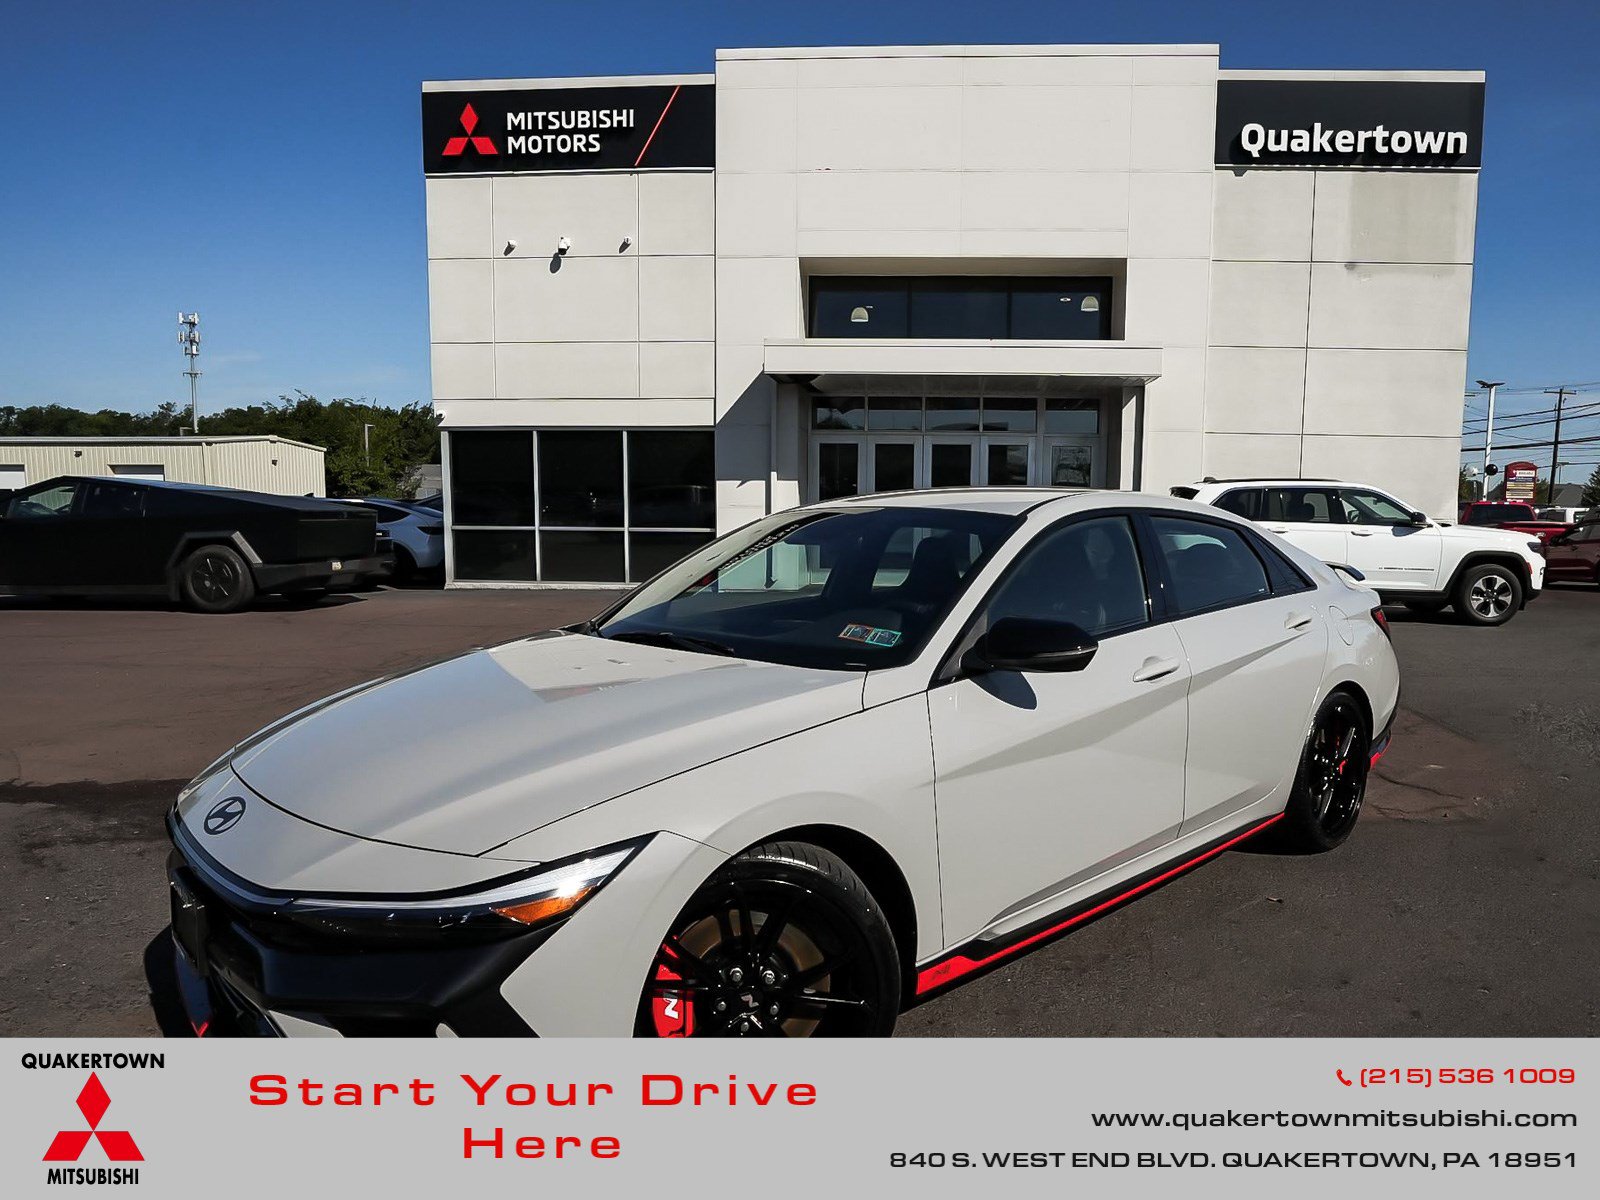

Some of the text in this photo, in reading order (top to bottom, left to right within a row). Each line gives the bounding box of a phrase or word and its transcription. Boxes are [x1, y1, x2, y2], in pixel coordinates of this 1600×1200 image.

[506, 109, 635, 131] MITSUBISHI
[507, 133, 601, 155] MOTORS
[1240, 121, 1469, 158] Quakertown
